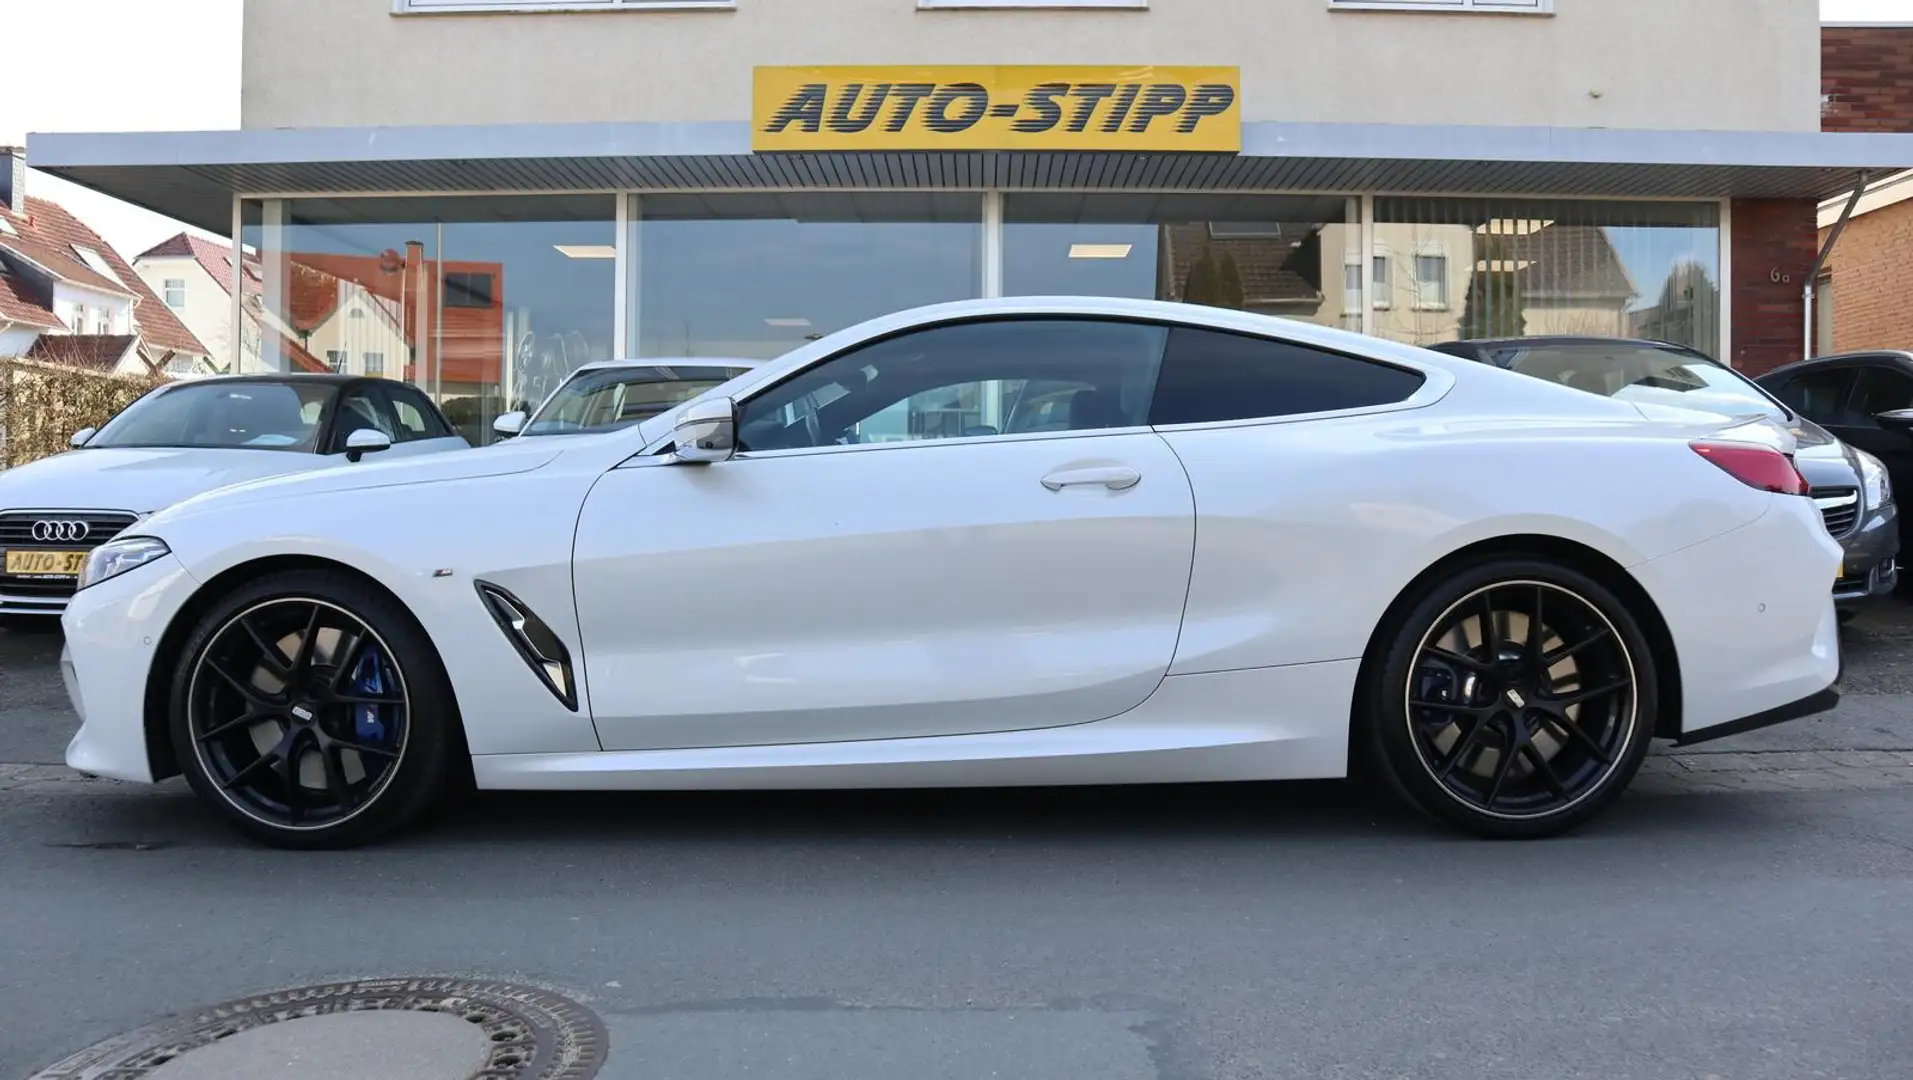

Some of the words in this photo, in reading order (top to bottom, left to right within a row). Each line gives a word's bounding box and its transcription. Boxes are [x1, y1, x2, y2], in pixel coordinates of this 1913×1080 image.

[763, 82, 1235, 134] AUTO-STIPP
[1770, 266, 1790, 283] 6a
[10, 553, 85, 571] AUTO-ST
